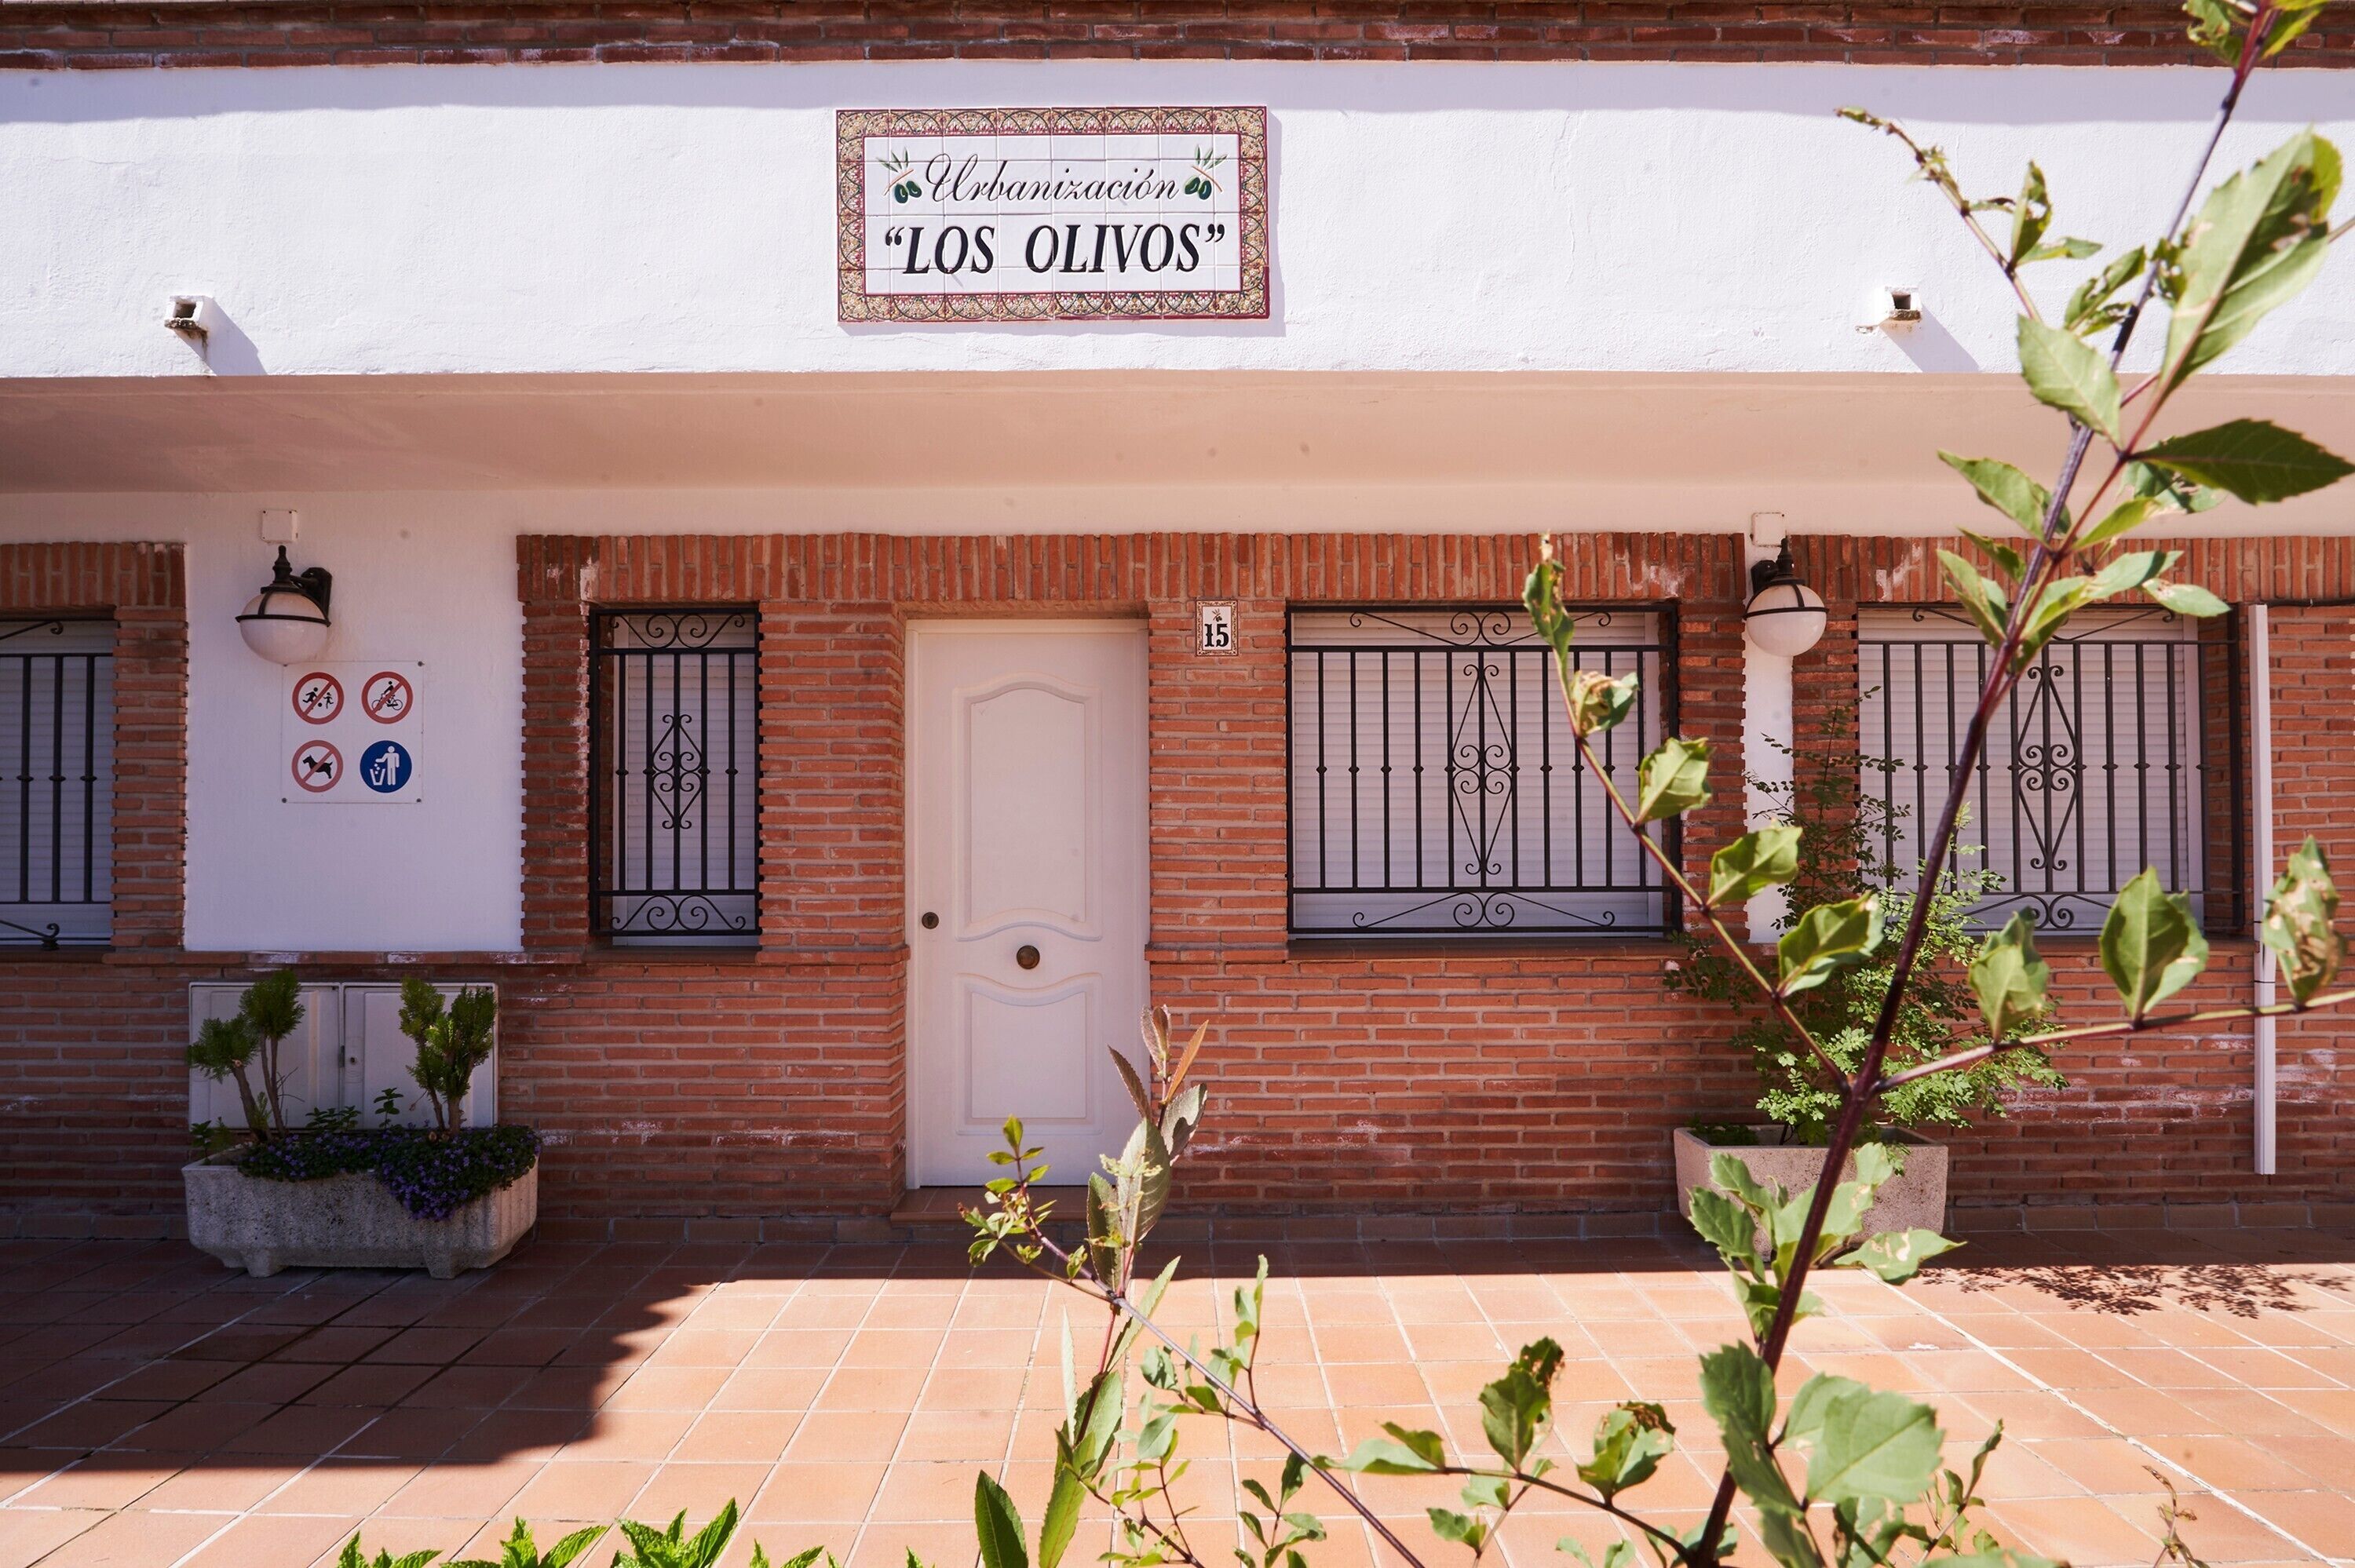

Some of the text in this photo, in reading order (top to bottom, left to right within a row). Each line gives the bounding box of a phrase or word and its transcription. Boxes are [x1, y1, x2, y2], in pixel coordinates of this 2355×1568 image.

[925, 153, 1180, 202] Urbanización
[884, 224, 1225, 275] “LOS OLIVOS”
[1204, 623, 1229, 647] 15
